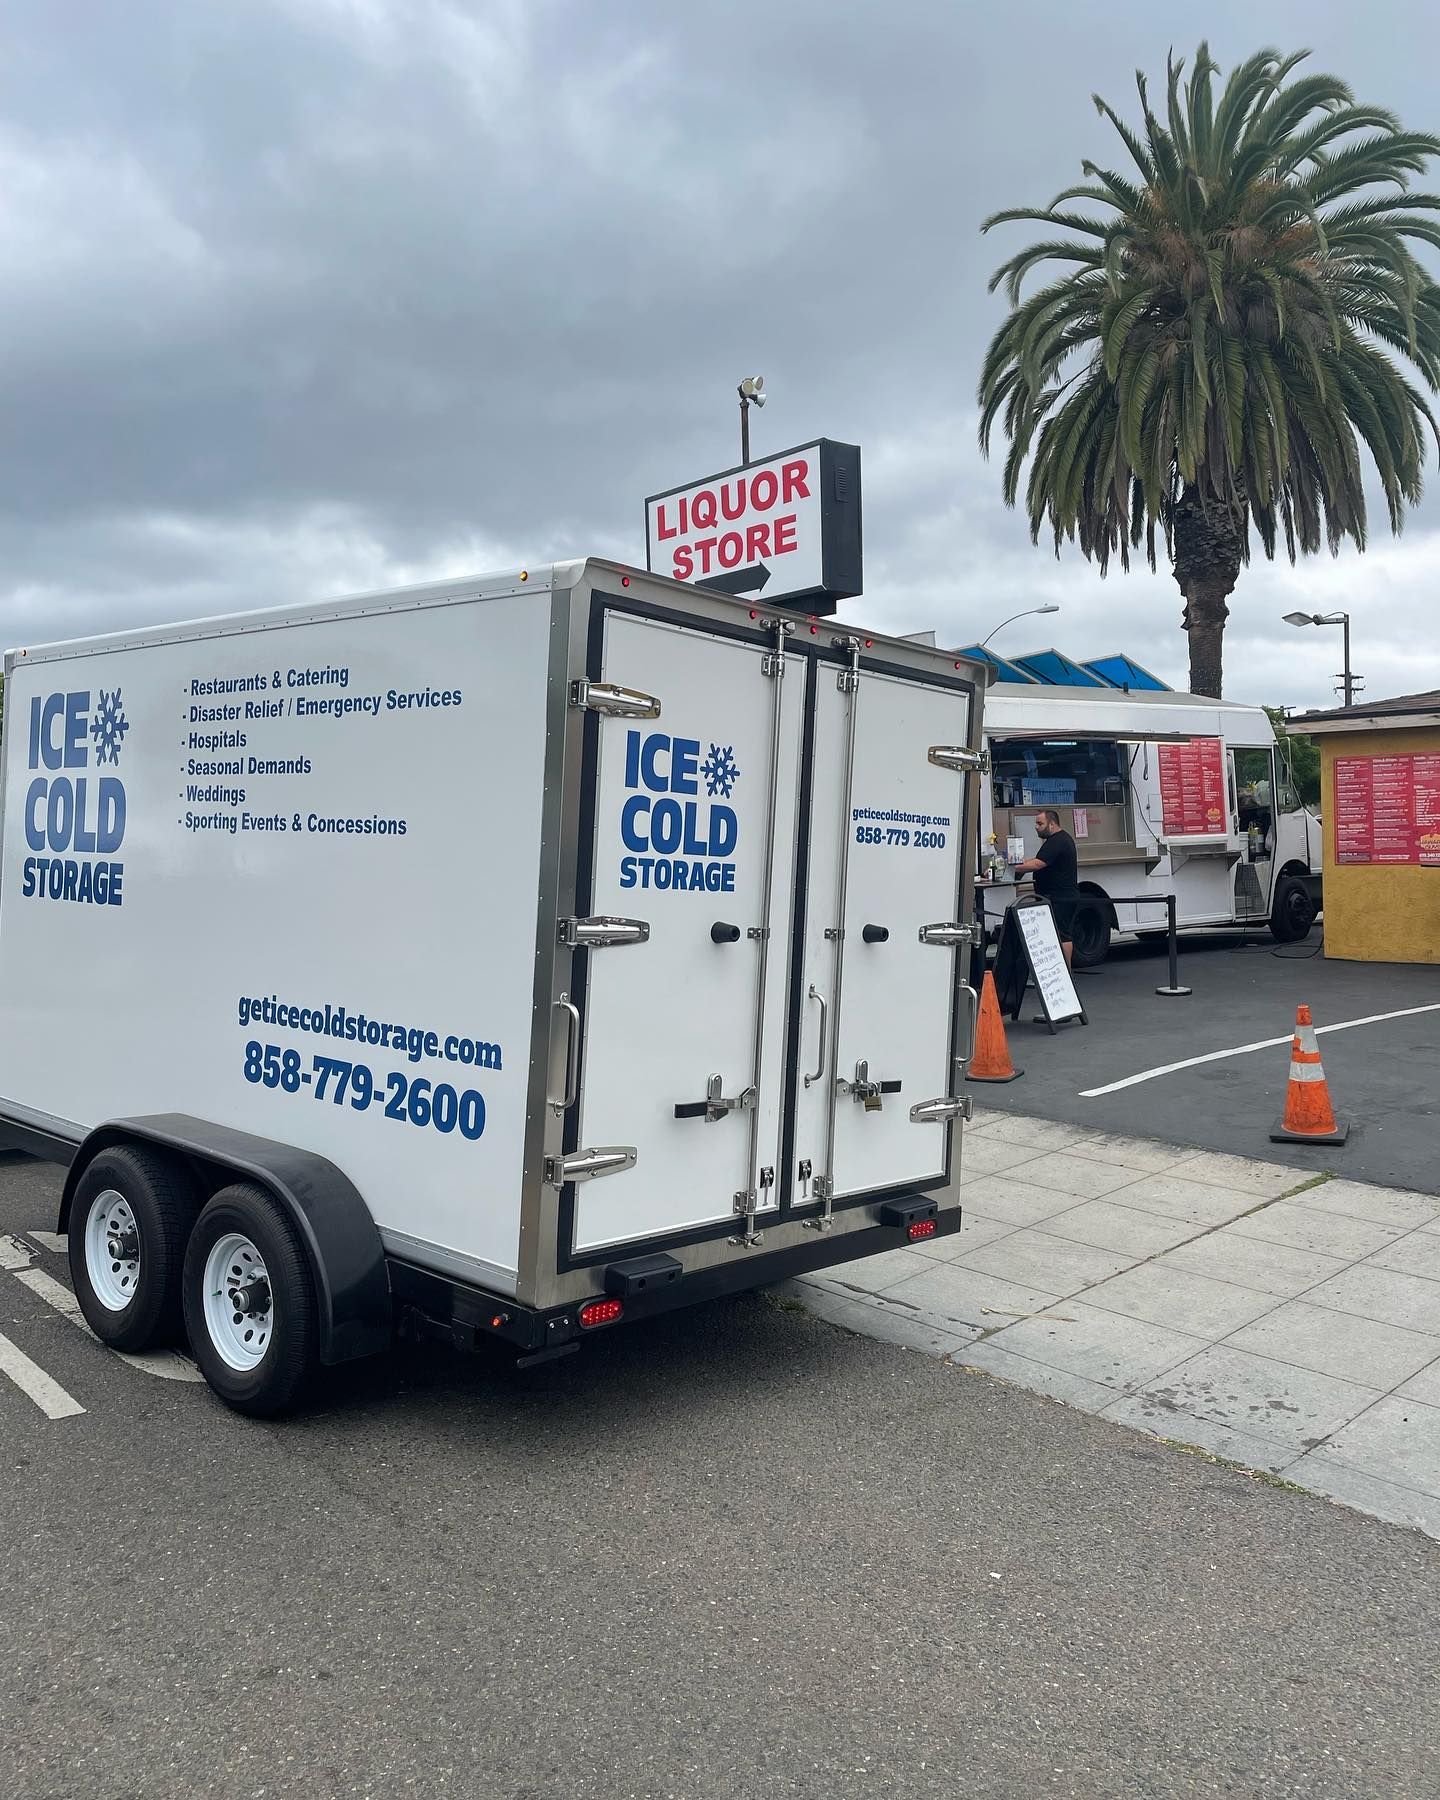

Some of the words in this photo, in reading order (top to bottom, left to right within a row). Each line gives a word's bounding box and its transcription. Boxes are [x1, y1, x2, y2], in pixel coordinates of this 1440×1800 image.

[657, 460, 810, 541] LIQUOR
[673, 514, 797, 580] STORE
[191, 673, 267, 696] Restaurants
[272, 671, 282, 689] &
[287, 666, 349, 688] Catering
[189, 702, 240, 723] Disaster
[245, 699, 284, 720] Relief
[297, 693, 381, 719] Emergency
[386, 687, 462, 708] Services
[28, 691, 91, 770] ICE
[189, 731, 247, 751] Hospitals
[187, 758, 243, 776] Seasonal
[248, 756, 311, 775] Demands
[625, 730, 700, 795] ICE
[24, 777, 126, 853] COLD
[186, 785, 246, 805] Weddings
[185, 812, 238, 833] Sporting
[242, 814, 287, 832] Events
[292, 814, 302, 832] &
[307, 815, 407, 836] Concessions
[621, 795, 738, 857] COLD
[853, 807, 950, 827] geticecoldstorage.com
[856, 826, 909, 846] 858-779
[914, 831, 945, 849] 2600
[22, 857, 123, 906] STORAGE
[620, 857, 735, 892] STORAGE
[239, 995, 502, 1070] geticecoldstorage.com
[244, 1040, 485, 1140] 858-779-2600
